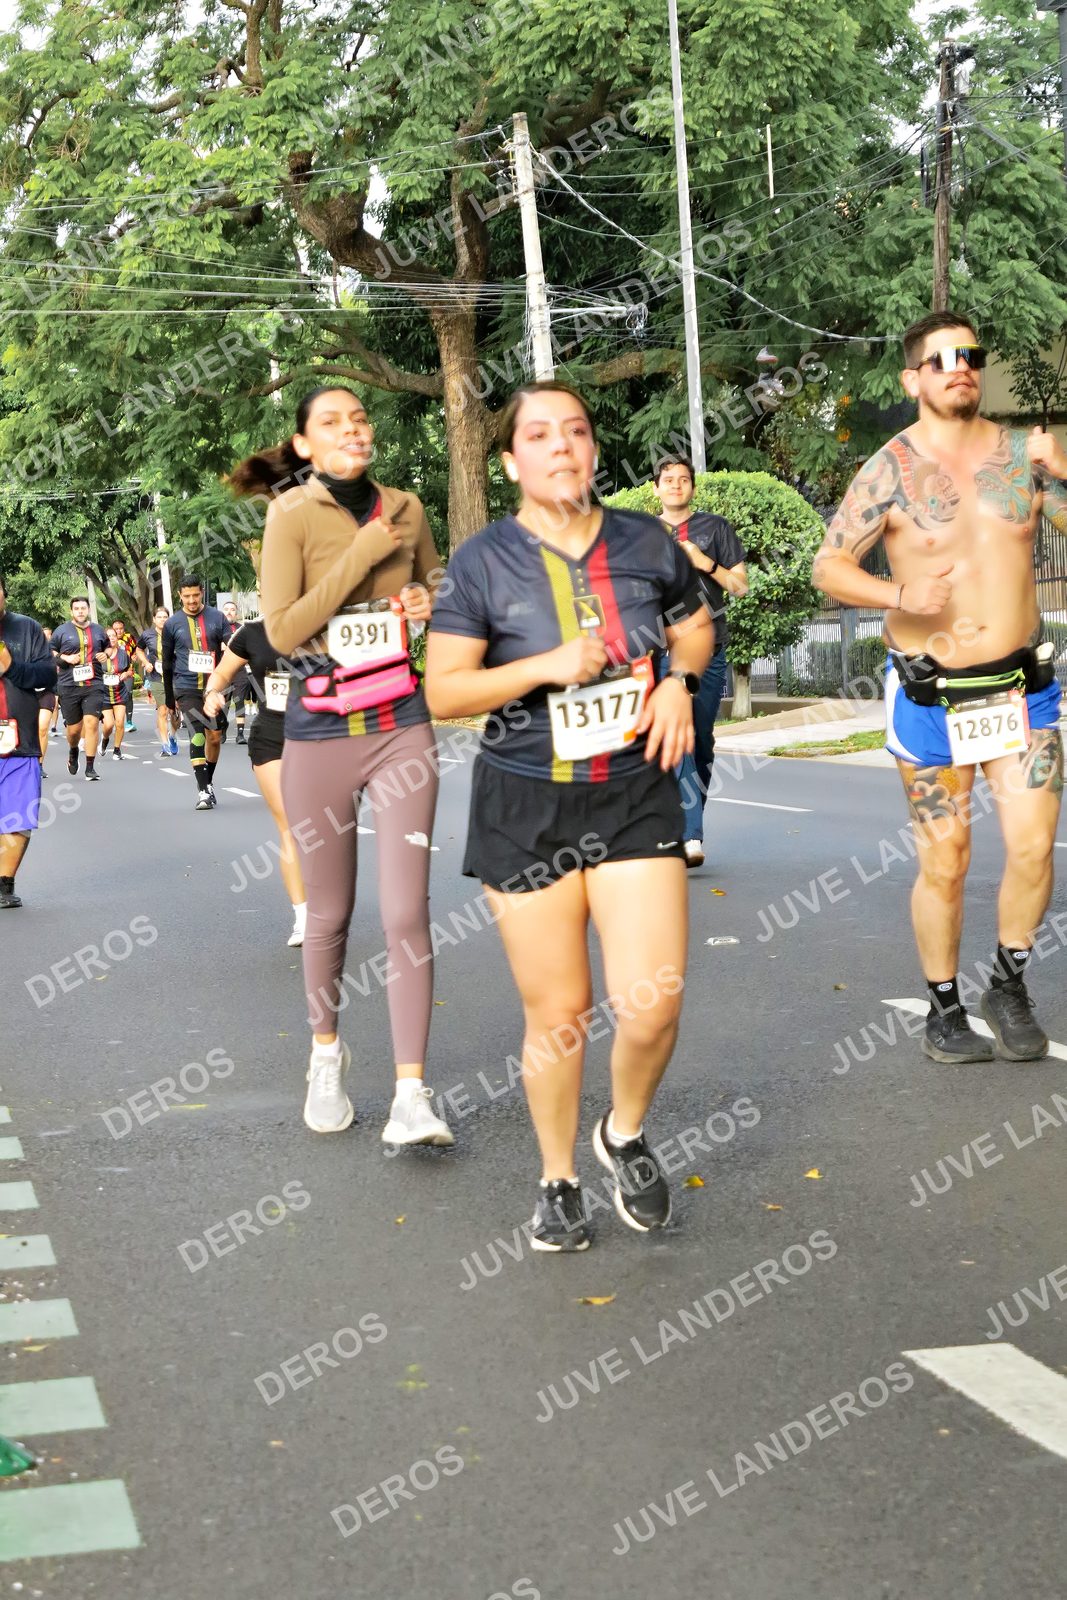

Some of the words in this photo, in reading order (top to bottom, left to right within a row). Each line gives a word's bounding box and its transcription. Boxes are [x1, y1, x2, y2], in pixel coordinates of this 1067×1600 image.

[340, 620, 388, 647] 9391
[271, 682, 288, 696] 82
[556, 689, 641, 729] 13177
[953, 712, 1018, 741] 12876
